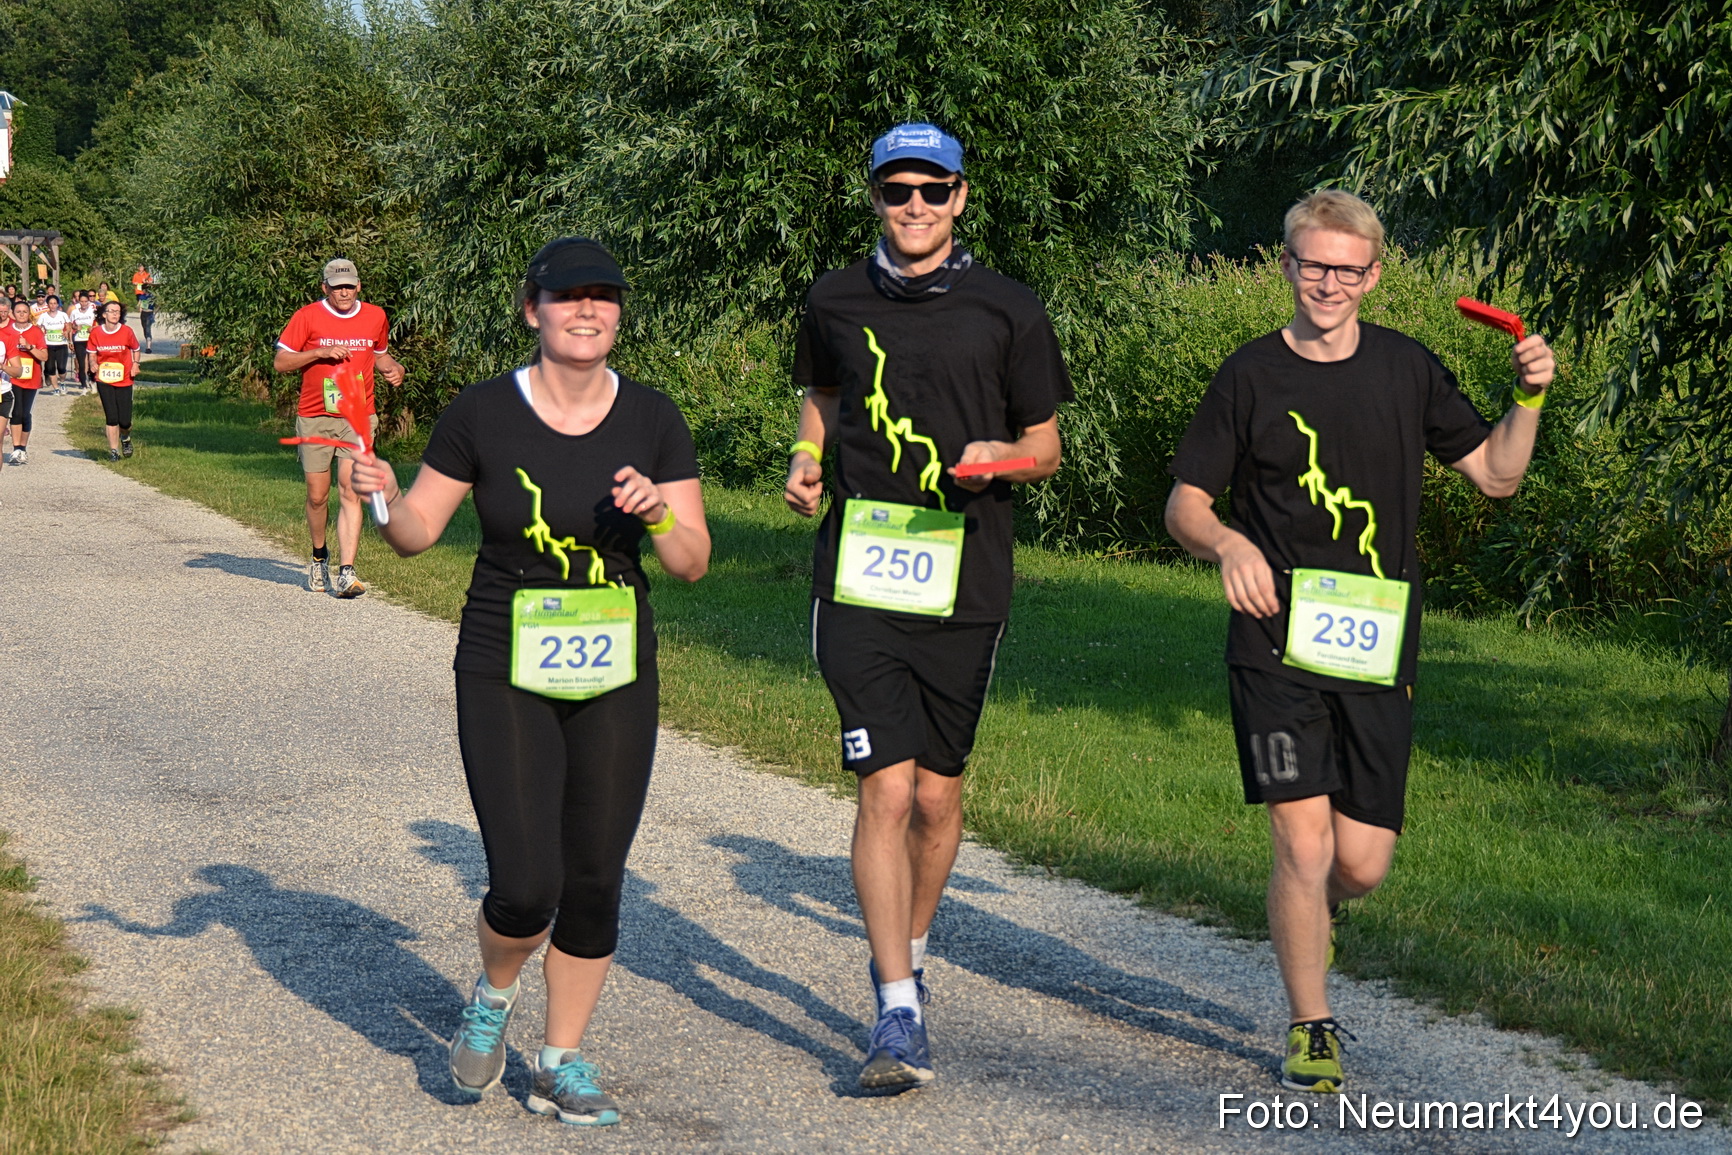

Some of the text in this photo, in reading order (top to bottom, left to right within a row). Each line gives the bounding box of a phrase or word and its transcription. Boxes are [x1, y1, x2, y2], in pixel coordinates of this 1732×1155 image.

[102, 370, 121, 378] 1414
[862, 545, 933, 583] 250
[1312, 612, 1379, 651] 239
[539, 634, 613, 669] 232
